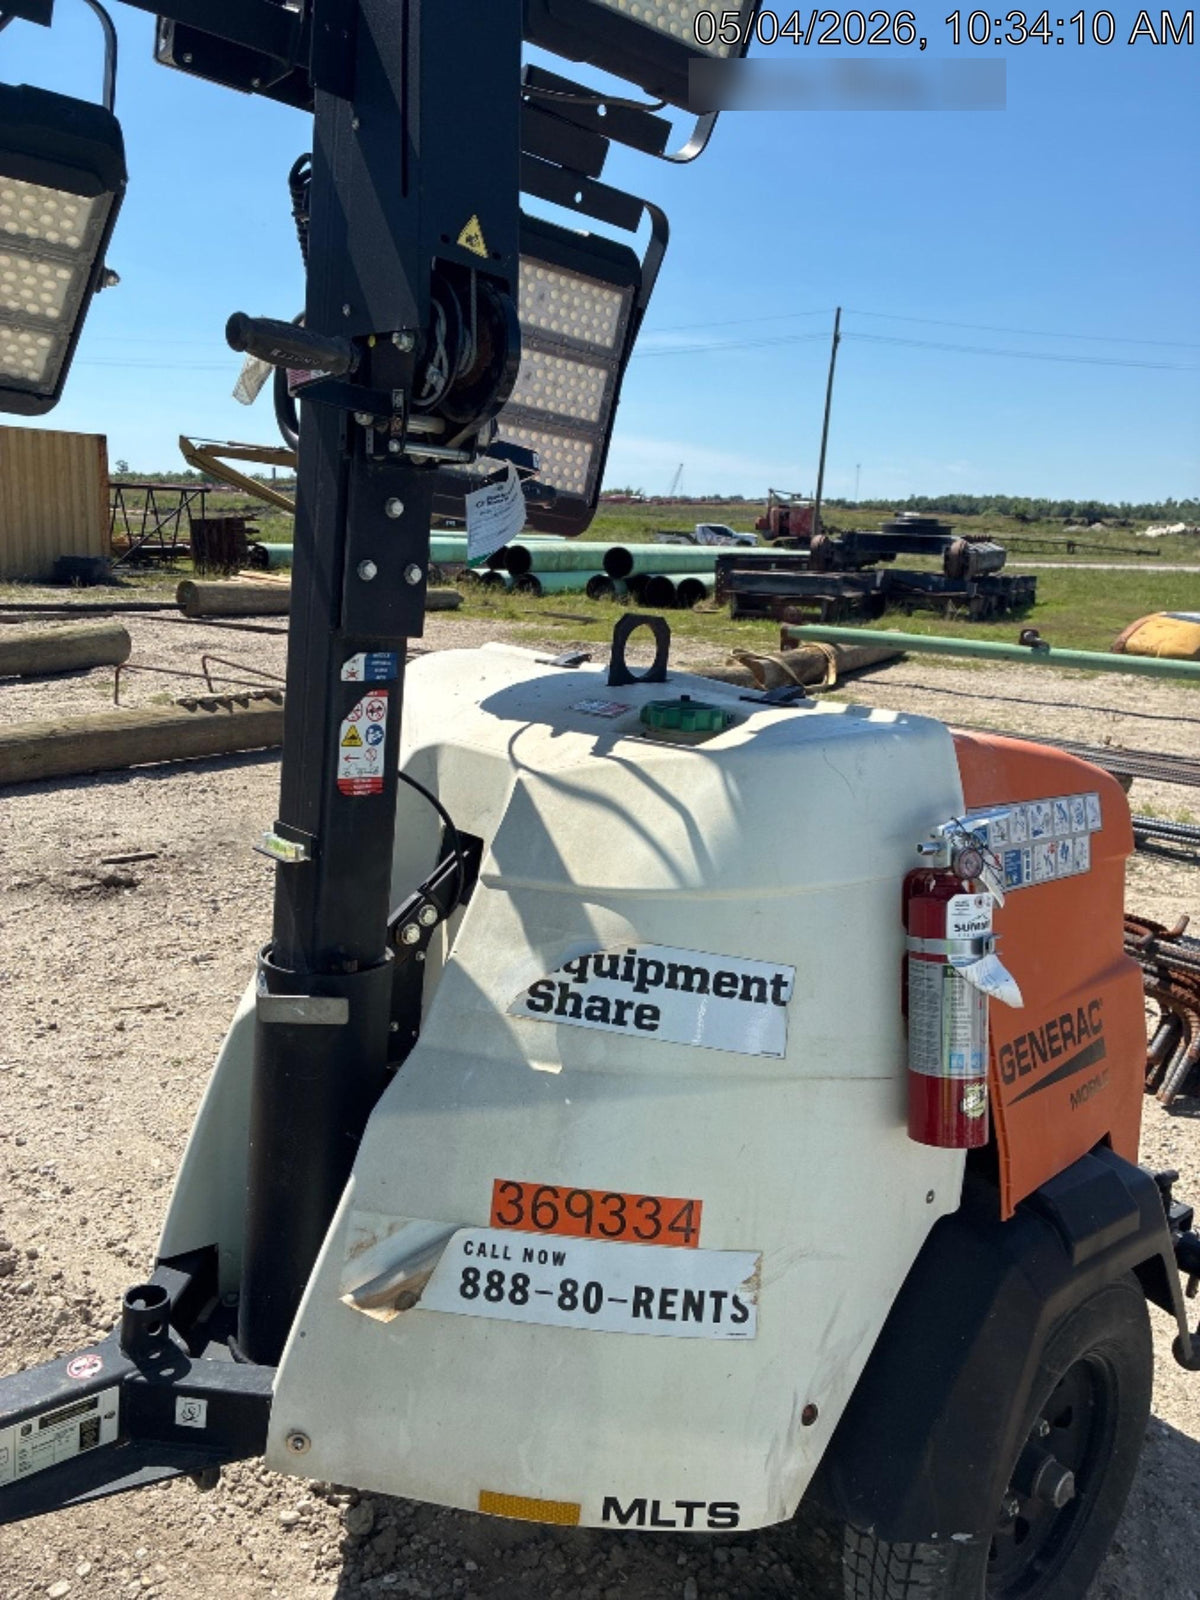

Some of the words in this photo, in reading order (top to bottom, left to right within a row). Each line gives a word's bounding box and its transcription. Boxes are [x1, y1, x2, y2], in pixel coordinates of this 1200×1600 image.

[525, 978, 661, 1032] Share
[552, 947, 790, 1007] quipment
[998, 998, 1104, 1086] GENERAC
[495, 1180, 698, 1245] 369334
[462, 1240, 513, 1261] CALL
[522, 1246, 568, 1267] NOW
[458, 1266, 750, 1325] 888-80-RENTS
[601, 1495, 741, 1529] MLTS
